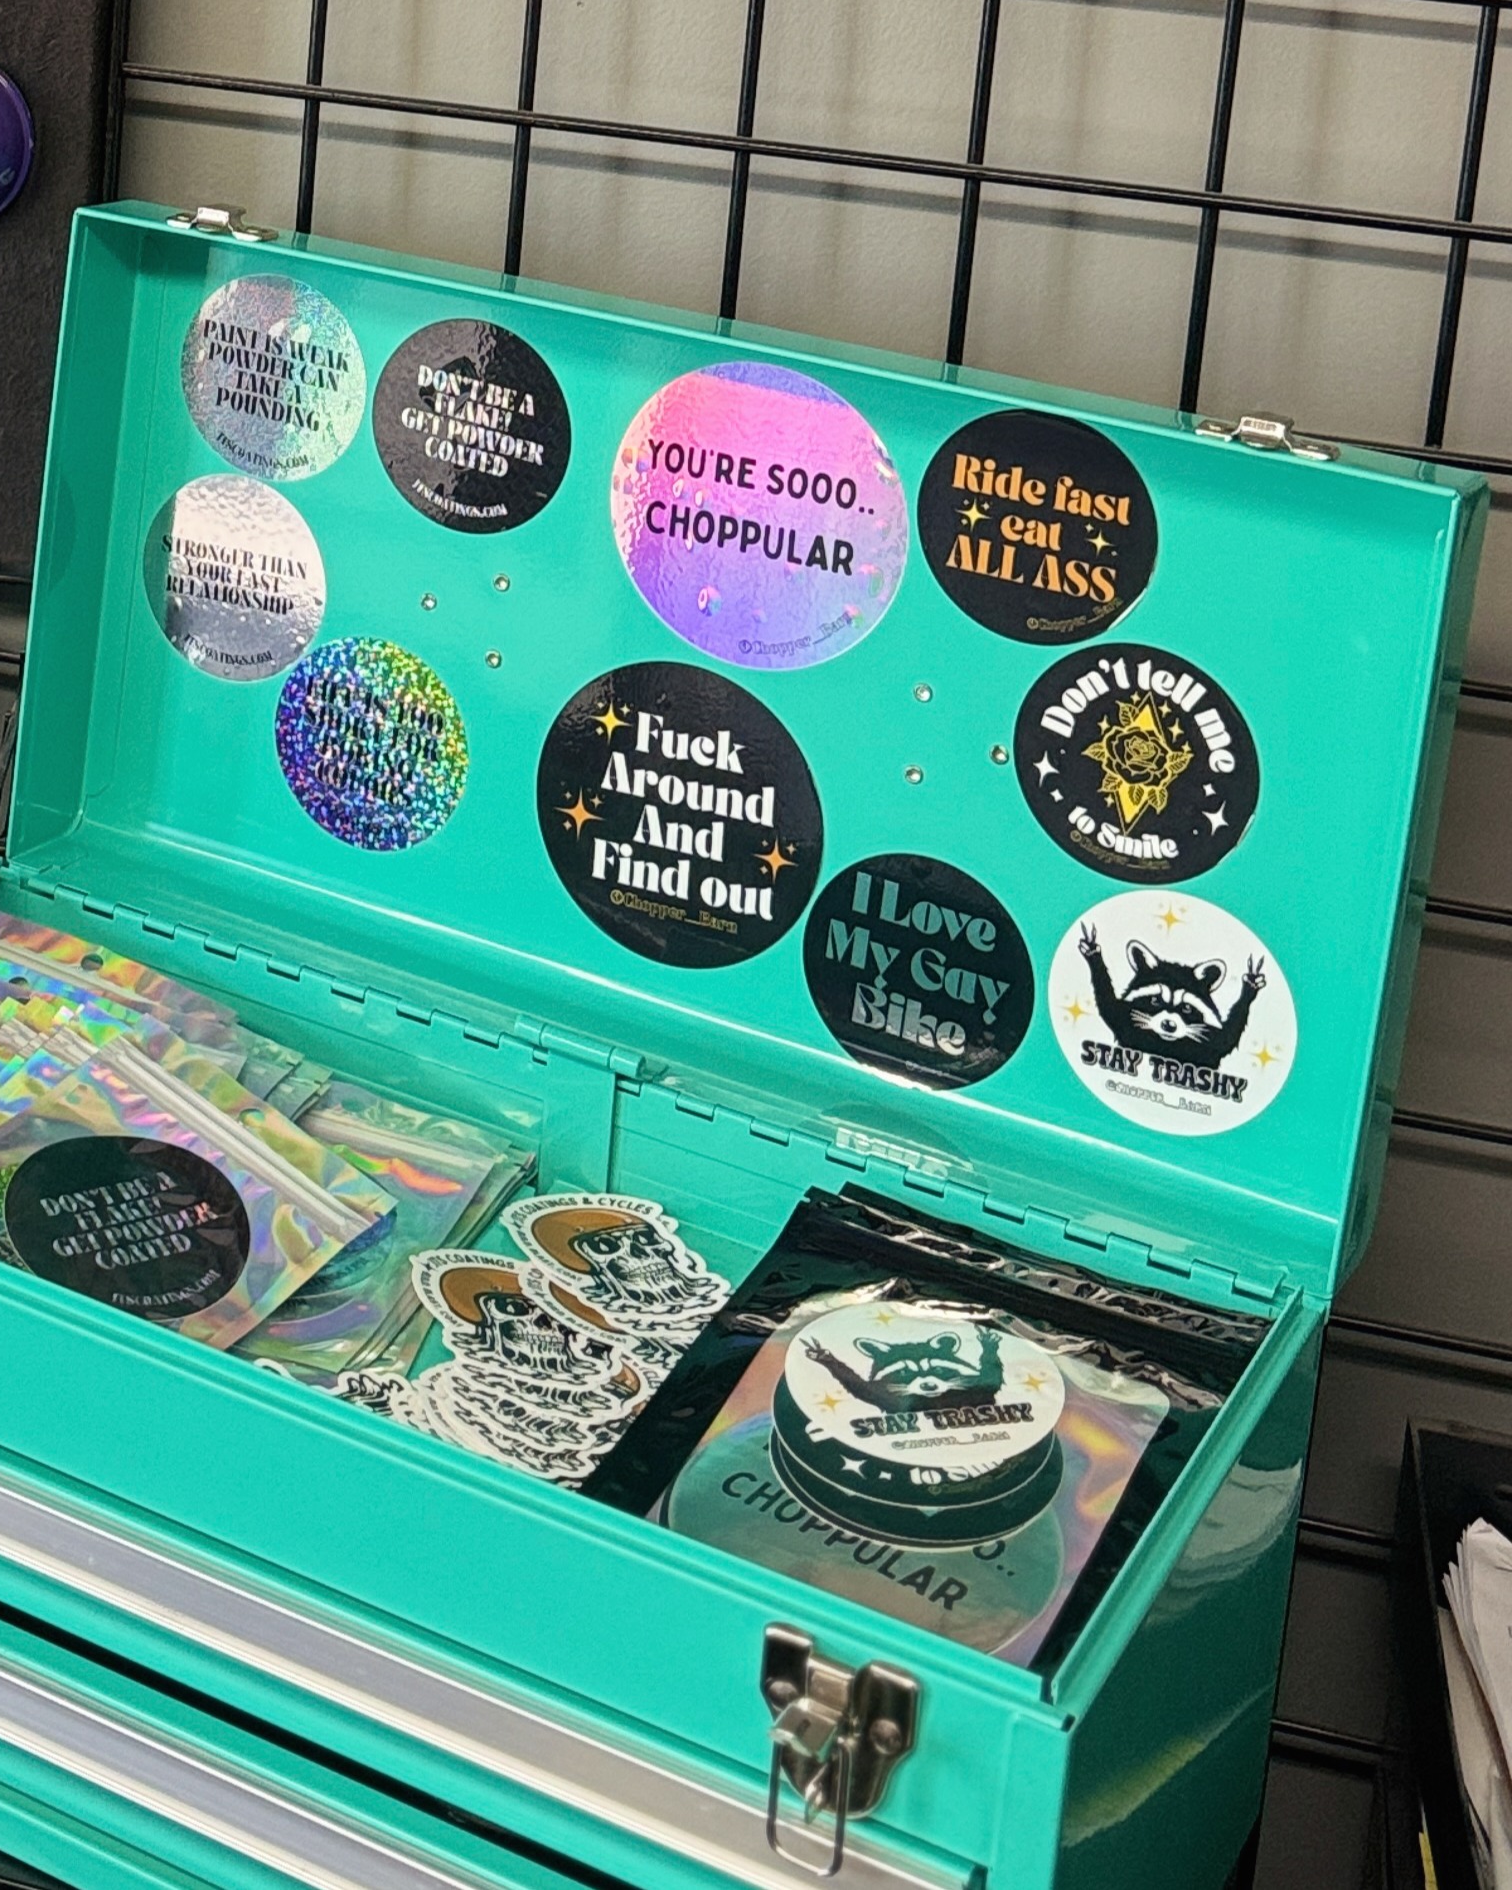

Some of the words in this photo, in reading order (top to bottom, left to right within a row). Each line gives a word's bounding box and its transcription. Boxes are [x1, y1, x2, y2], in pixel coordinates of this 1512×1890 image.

[203, 319, 258, 349] PAINT
[265, 335, 283, 355] IS
[289, 341, 349, 372] WEAK
[209, 342, 294, 380] POWDER
[301, 365, 338, 391] CAN
[216, 387, 320, 431] POUNDING
[236, 369, 280, 398] TAKE
[285, 385, 301, 404] A
[418, 365, 484, 401] DON'T
[486, 383, 517, 411] BE
[519, 393, 535, 416] A
[402, 407, 444, 435] GET
[447, 419, 544, 466] POWDER
[435, 393, 512, 432] FLAKE!
[425, 436, 508, 477] COATED
[647, 439, 757, 490] YOU'RE
[952, 454, 1046, 507] Ride
[1053, 476, 1132, 526] fast
[162, 535, 254, 569] STRONGER
[258, 554, 307, 579] THAN
[646, 501, 854, 576] CHOPPULAR
[1000, 512, 1062, 551] eat
[187, 559, 232, 584] YOUR
[238, 569, 279, 593] LAST
[946, 533, 1024, 584] ALL
[1033, 565, 1117, 603] ASS
[167, 575, 294, 615] RELATIONSHIP
[1040, 658, 1130, 738] Don't
[1137, 659, 1208, 712] tell
[1194, 707, 1236, 774] me
[635, 711, 745, 775] Fuck
[601, 751, 775, 827] Around
[633, 806, 724, 863] And
[1068, 806, 1095, 834] to
[1097, 822, 1179, 859] Smile
[591, 838, 689, 901] Find
[700, 877, 774, 922] out
[851, 871, 872, 915] I
[825, 919, 898, 990] My
[852, 982, 966, 1056] Bike
[1081, 1040, 1143, 1076] STAY
[1150, 1056, 1248, 1103] TRASHY
[40, 1186, 114, 1217] DON'T
[116, 1177, 155, 1201] BE
[156, 1171, 177, 1191] A
[522, 1197, 578, 1216] COATINGS
[582, 1197, 593, 1205] &
[598, 1197, 654, 1215] CYCLES
[53, 1231, 102, 1257] GET
[104, 1202, 218, 1246] POWDER
[95, 1233, 191, 1270] COATED
[447, 1254, 515, 1269] COATINGS
[850, 1412, 920, 1438] STAY
[923, 1403, 1034, 1430] TRASHY
